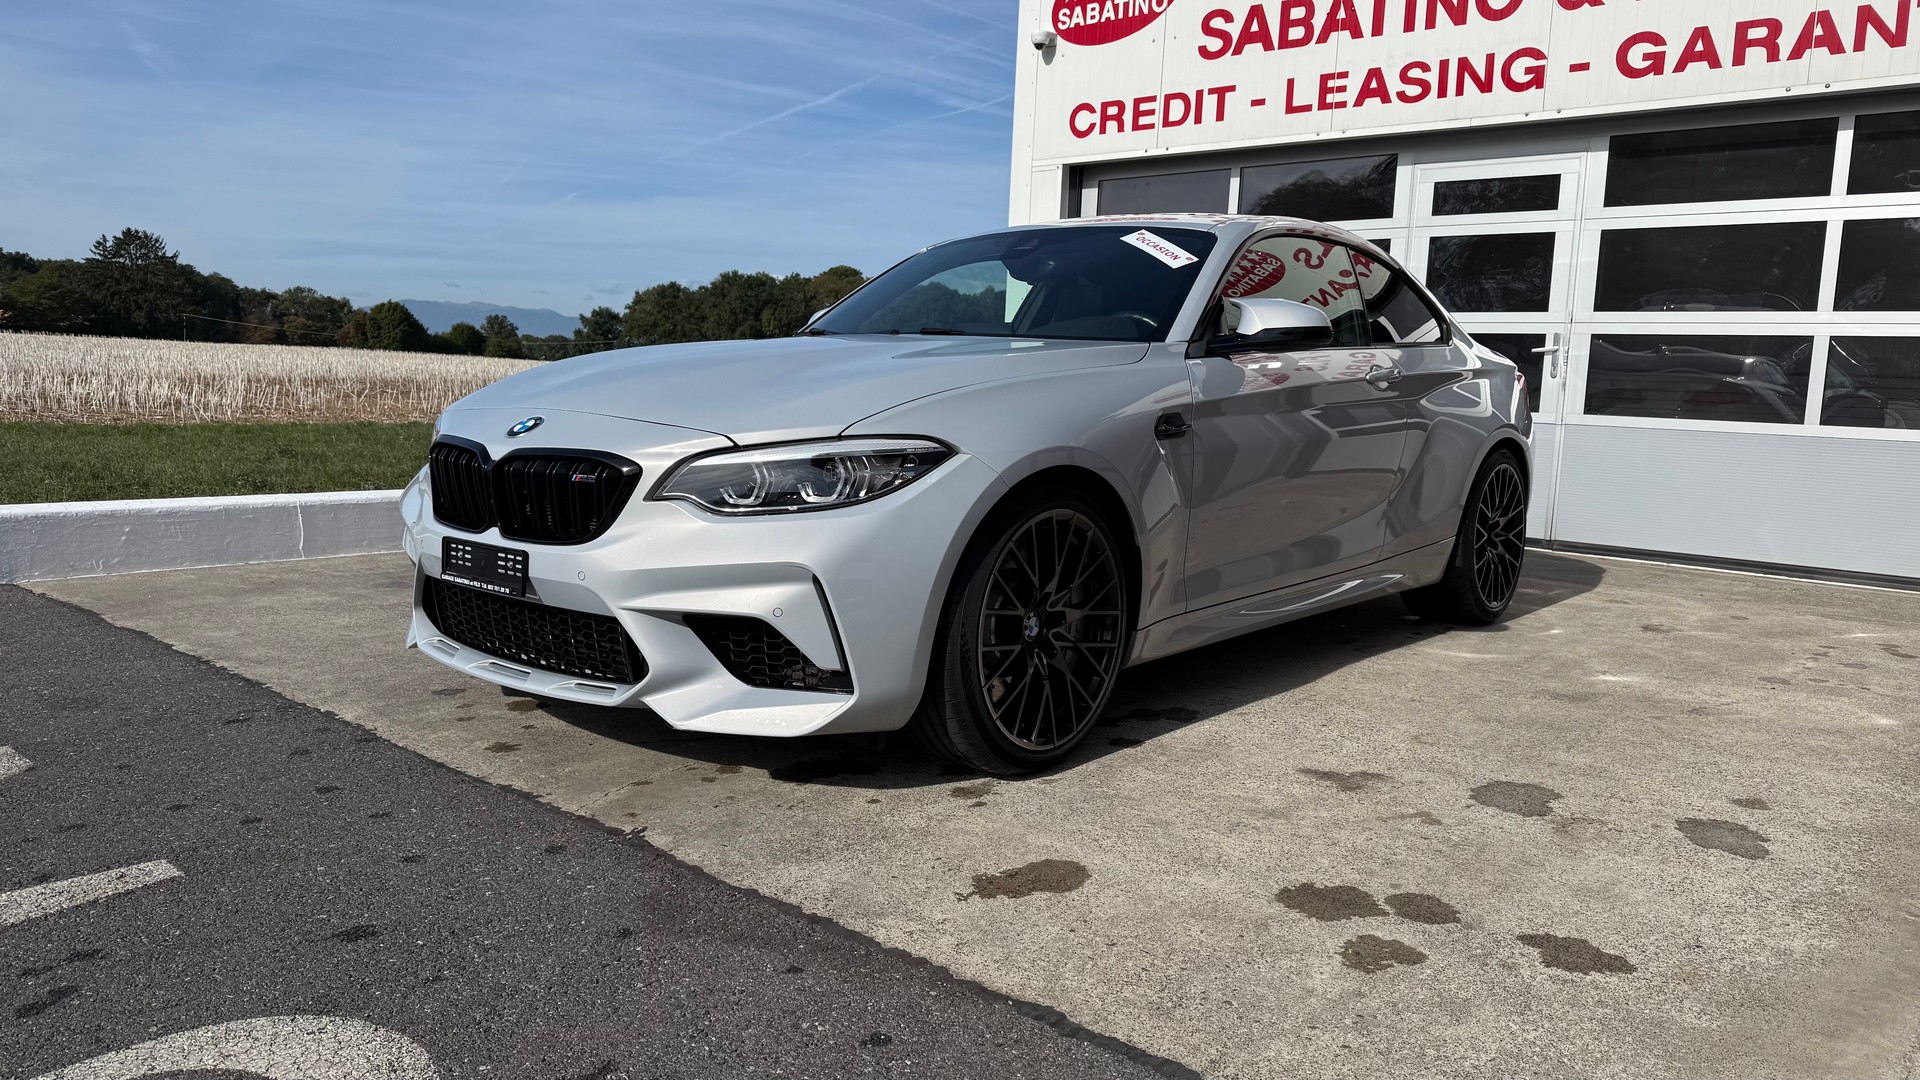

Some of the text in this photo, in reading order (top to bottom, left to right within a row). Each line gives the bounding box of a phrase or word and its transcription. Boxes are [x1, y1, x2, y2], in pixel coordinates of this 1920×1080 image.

[1057, 0, 1168, 30] SABATINO
[1069, 85, 1237, 139] CREDIT
[1285, 47, 1548, 115] LEASING
[1615, 0, 1920, 80] GARAN
[1136, 236, 1181, 261] OCCASION
